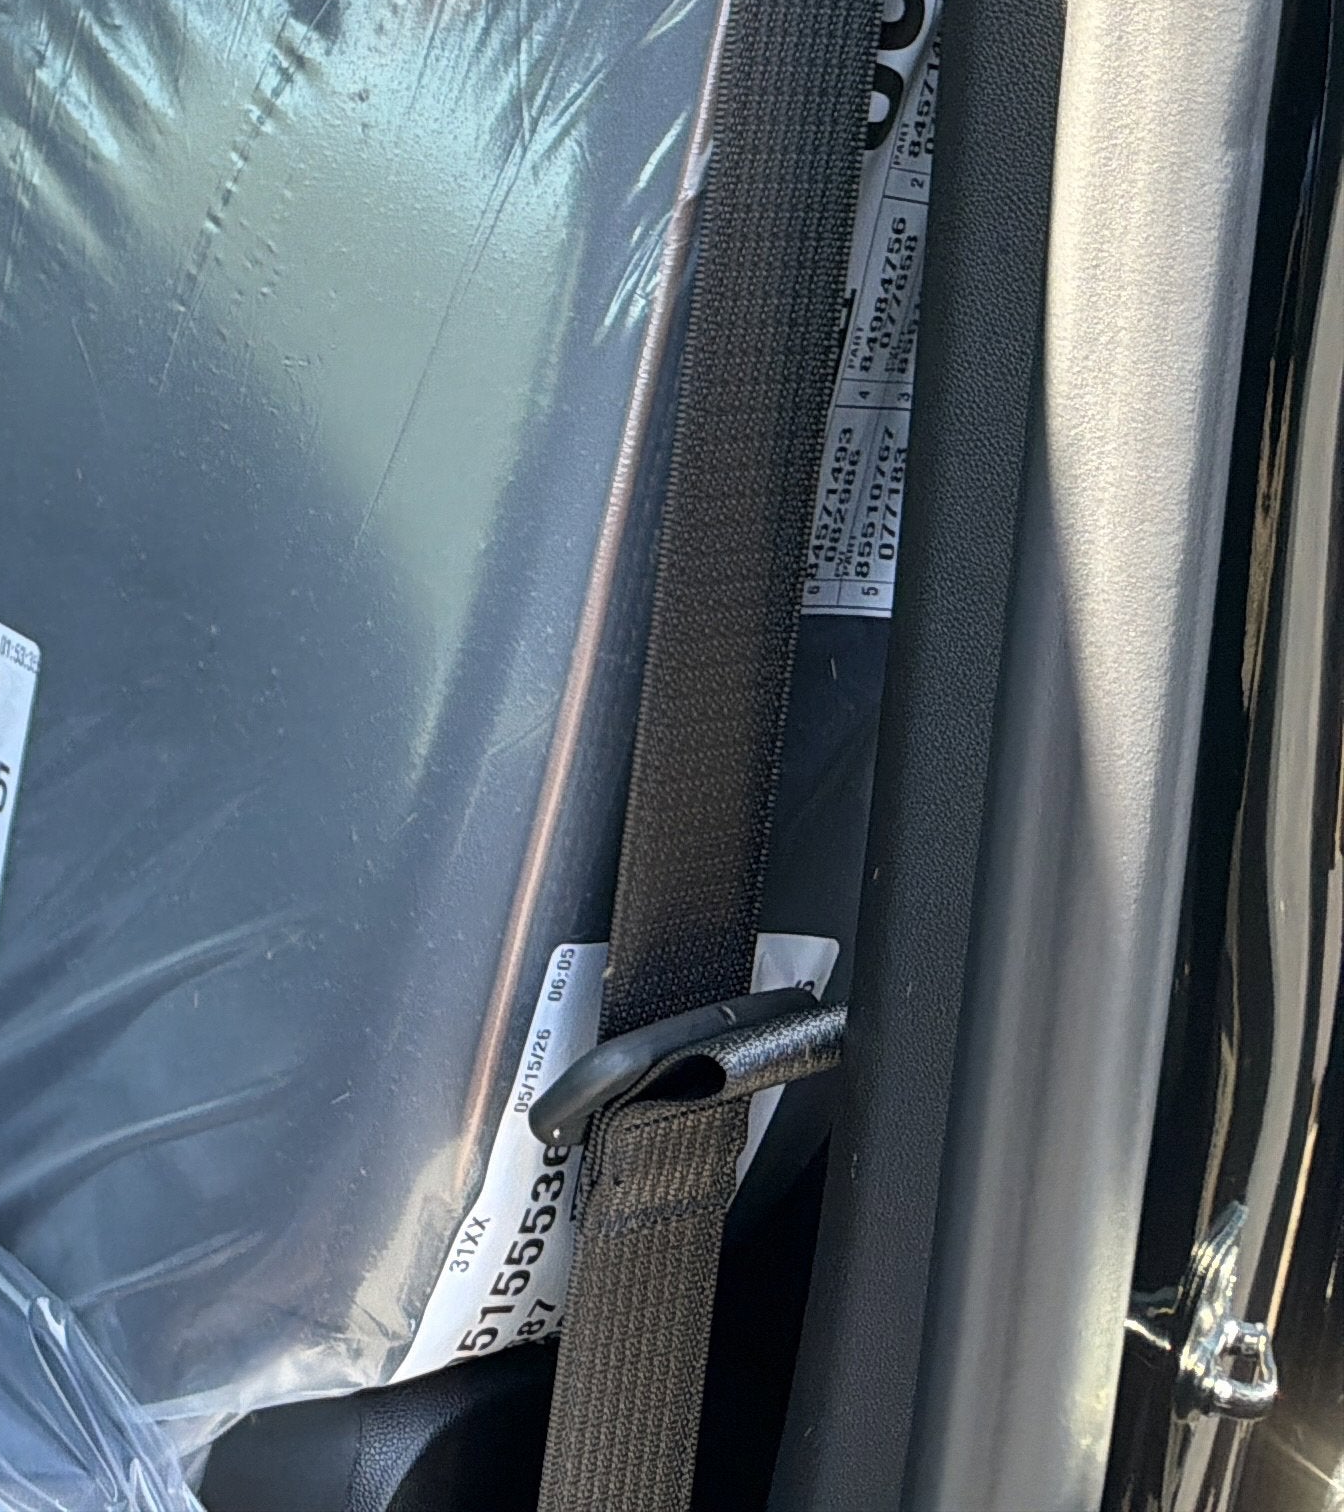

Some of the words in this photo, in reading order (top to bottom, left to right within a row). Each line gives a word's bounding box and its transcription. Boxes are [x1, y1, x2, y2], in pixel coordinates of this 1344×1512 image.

[859, 216, 907, 374] 84984756
[854, 425, 895, 579] 85510767
[861, 585, 880, 597] 5
[513, 1028, 552, 1113] 05/15/26
[547, 947, 575, 1002] 06:05
[448, 1215, 492, 1274] 31XX
[455, 1144, 572, 1352] 5155536
